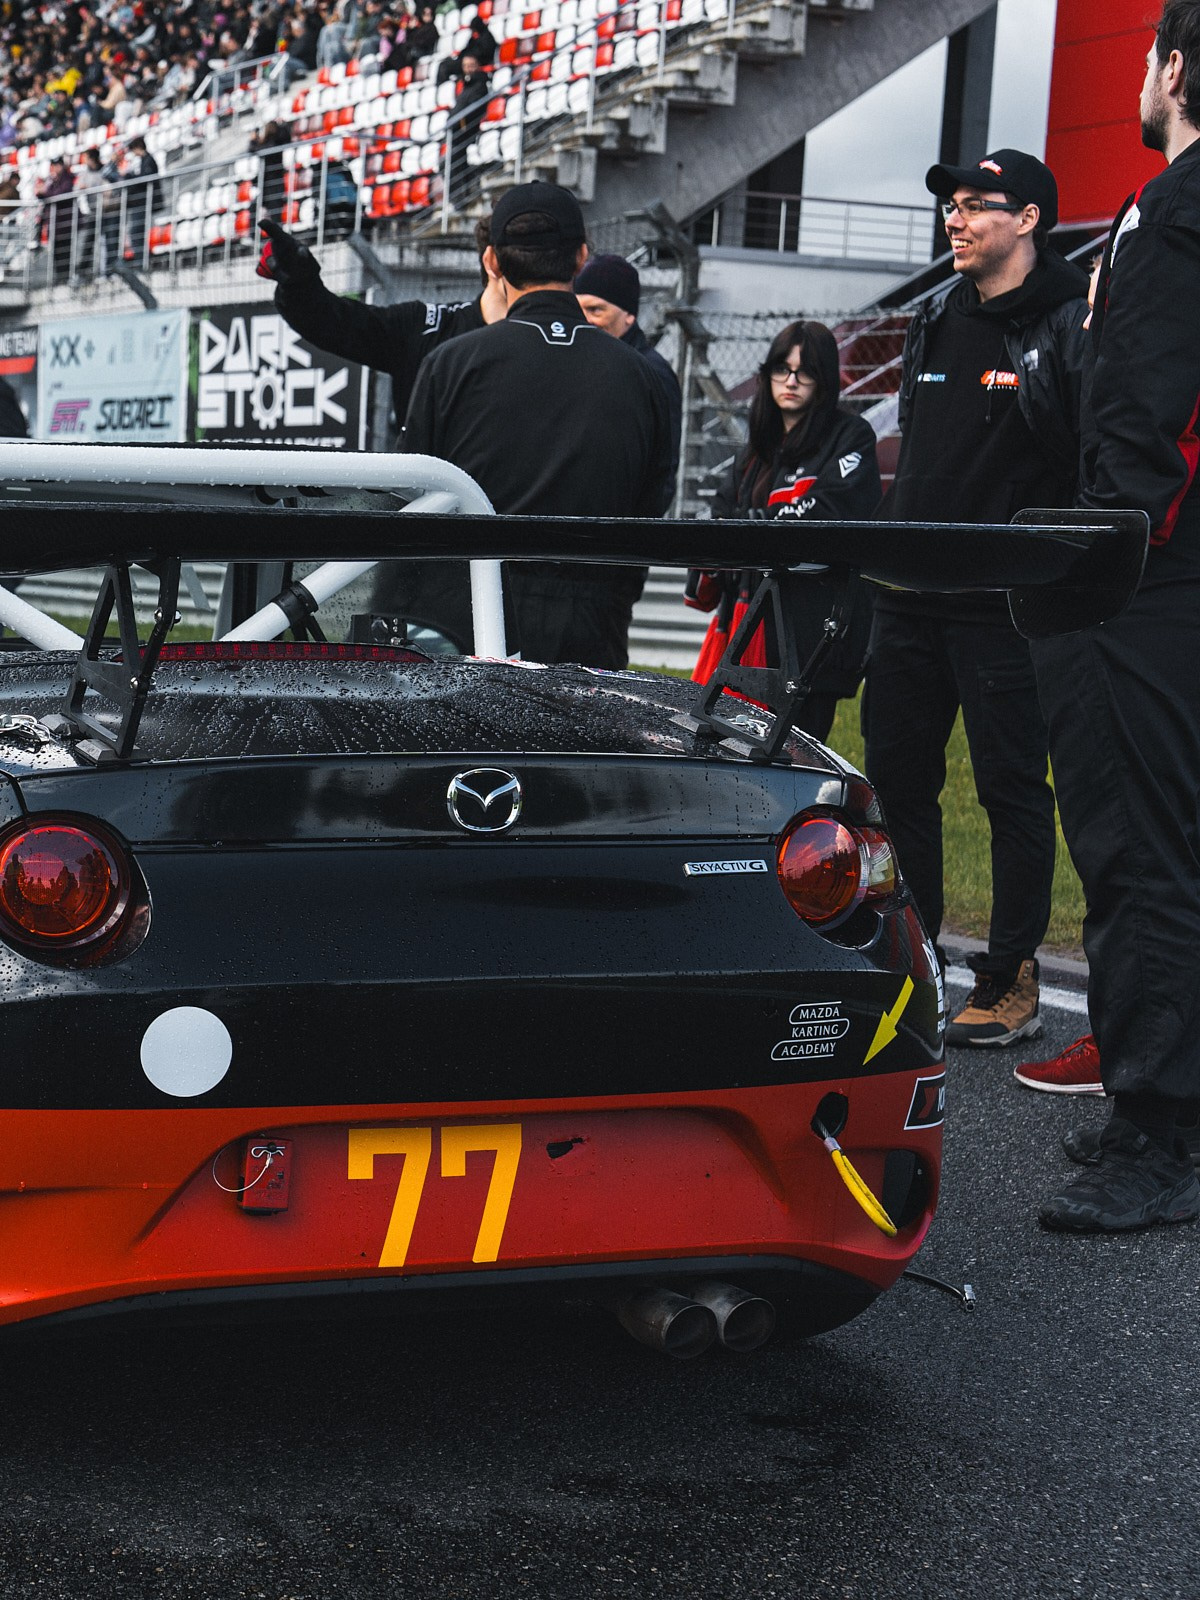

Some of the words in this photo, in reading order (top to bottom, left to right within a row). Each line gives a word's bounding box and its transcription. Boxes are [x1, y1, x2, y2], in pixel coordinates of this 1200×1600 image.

[199, 314, 312, 374] DARK
[197, 364, 349, 431] STOCK
[791, 1024, 839, 1038] KARTING
[799, 1006, 840, 1020] MAZDA
[781, 1042, 836, 1056] ACADEMY
[348, 1123, 522, 1267] 77
